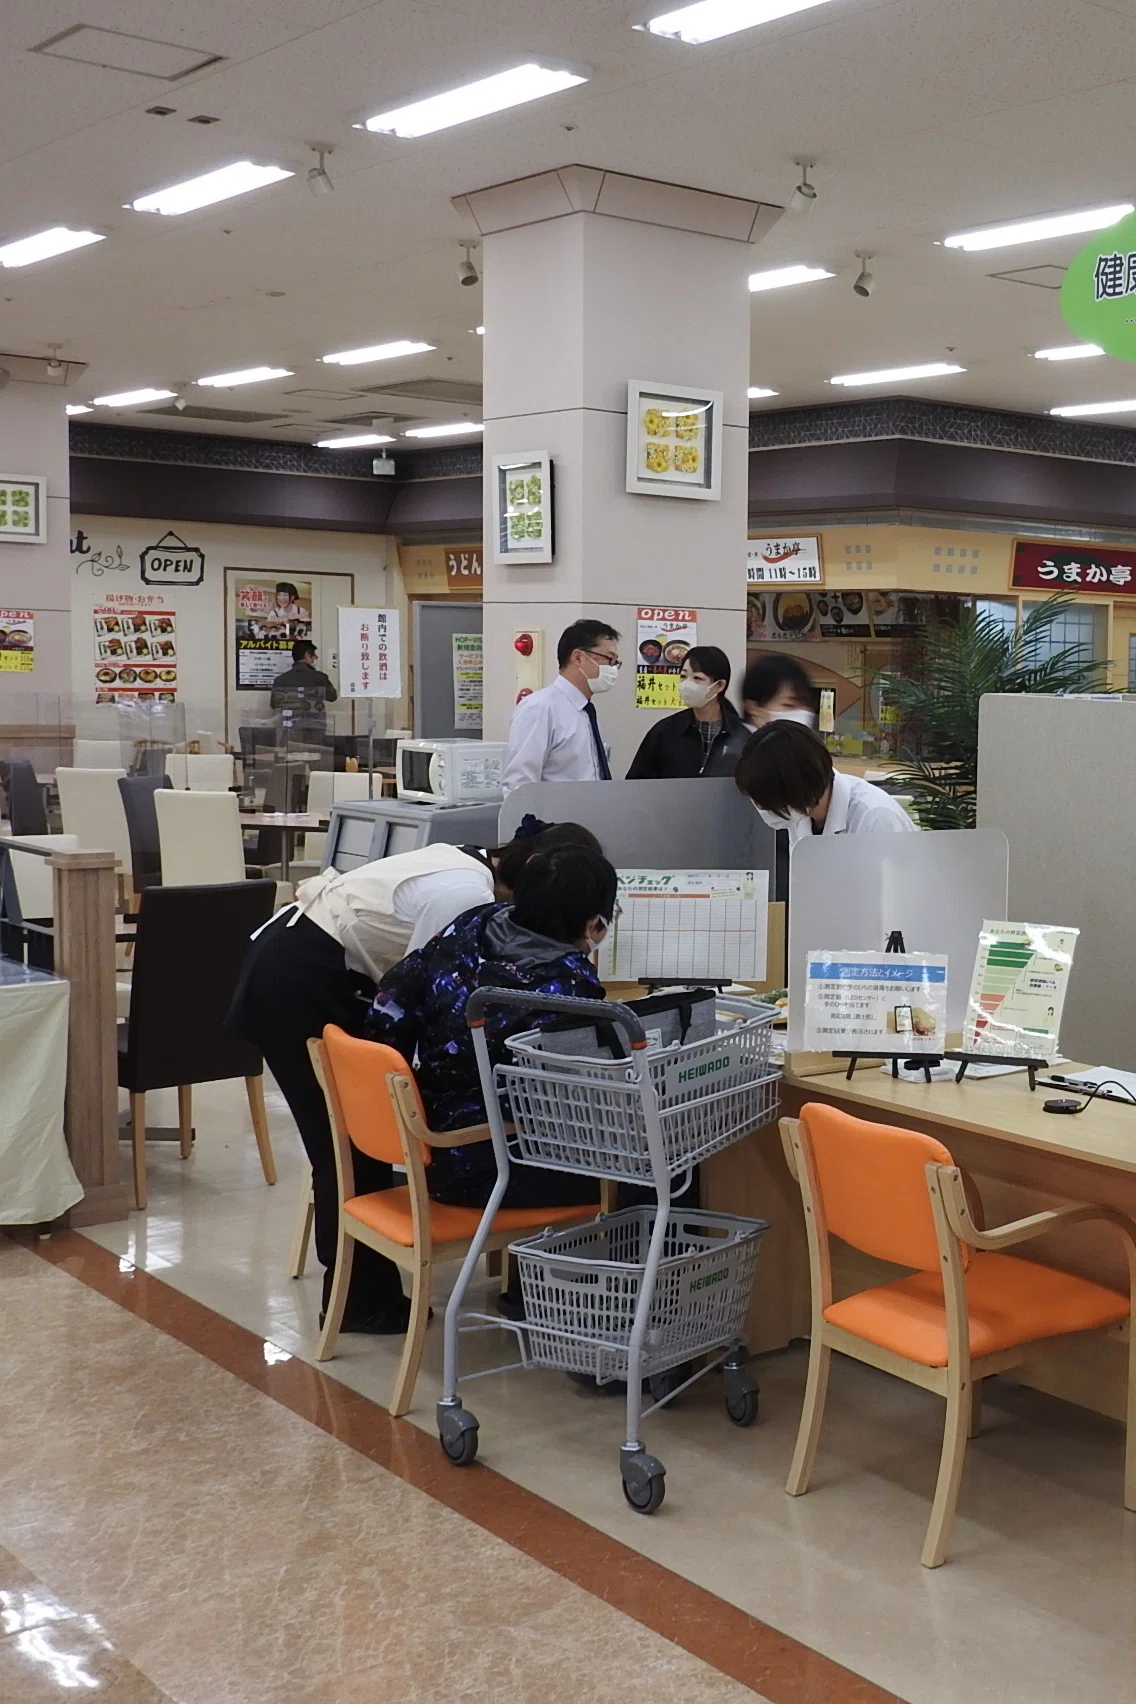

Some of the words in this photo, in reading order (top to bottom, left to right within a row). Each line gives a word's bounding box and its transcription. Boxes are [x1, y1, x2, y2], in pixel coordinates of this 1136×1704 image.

[765, 541, 802, 557] うまか亭
[150, 557, 194, 573] OPEN
[448, 553, 482, 576] うどん
[1037, 559, 1132, 586] うまか亭
[640, 608, 692, 621] open
[360, 623, 370, 691] お断り致します
[377, 613, 388, 681] 館内での飲酒は
[840, 966, 913, 978] 測定方法とイメージ
[678, 1055, 731, 1085] HEIWADO
[689, 1267, 730, 1294] HEIWADO
